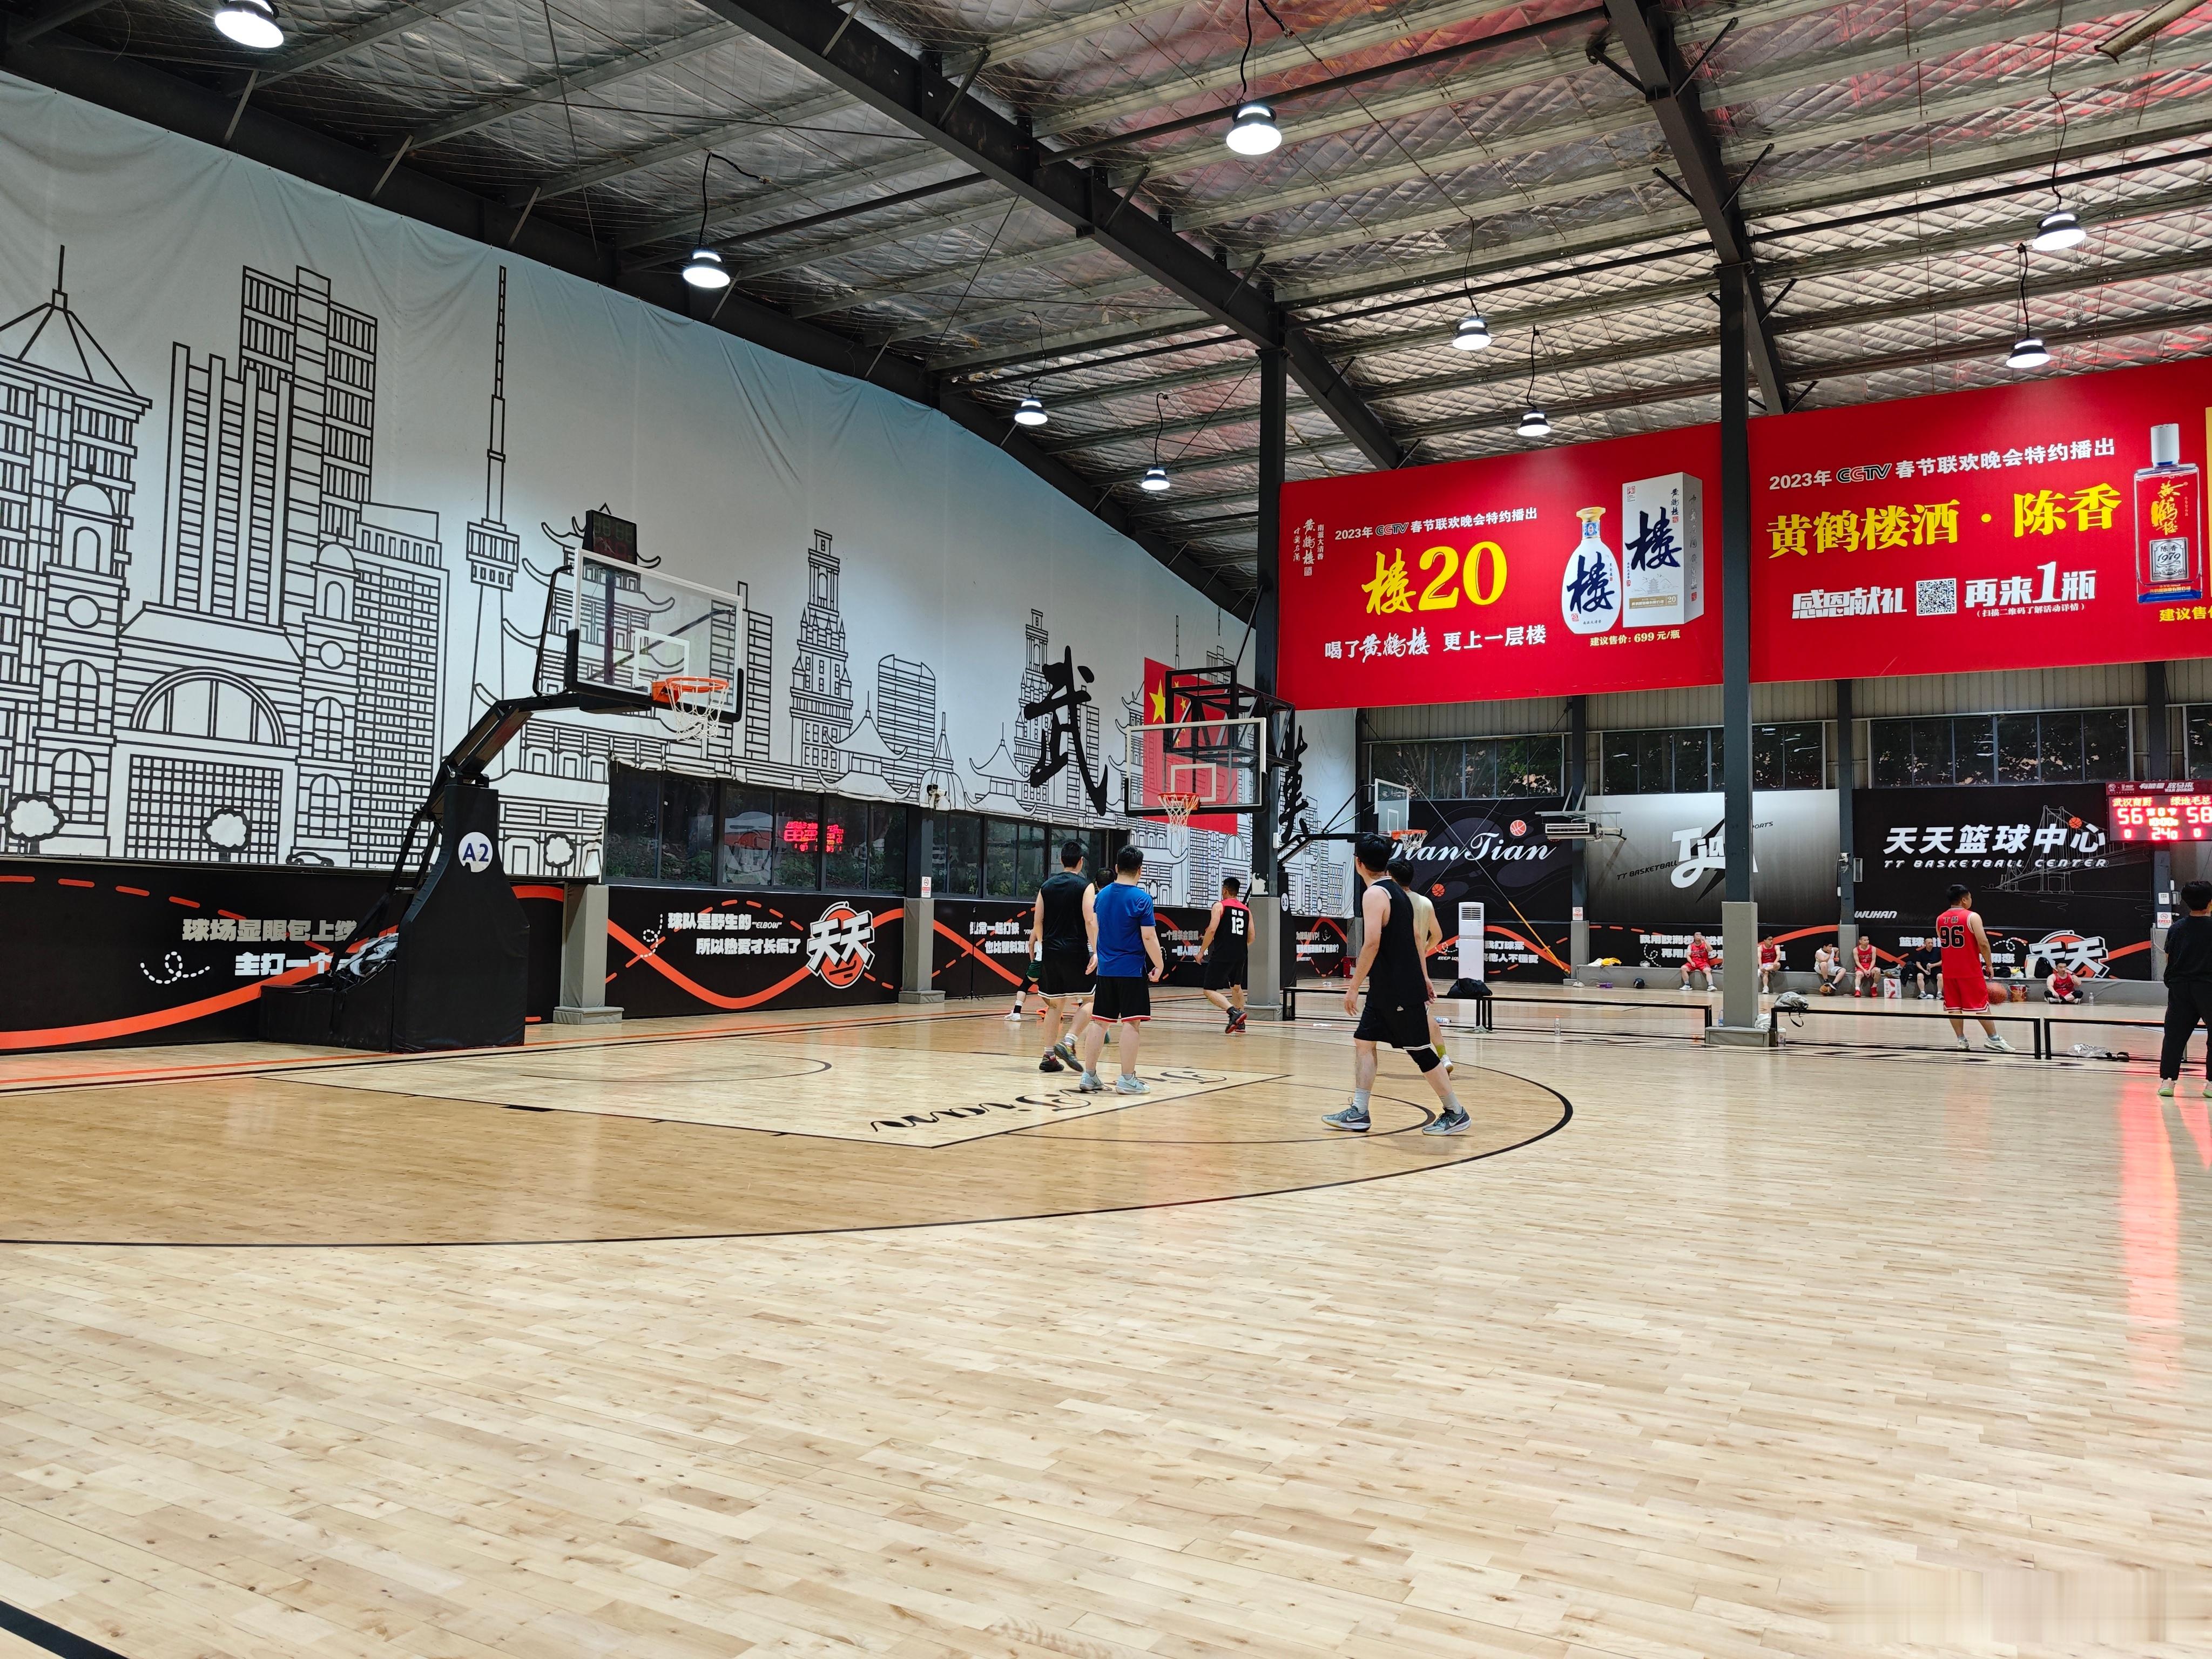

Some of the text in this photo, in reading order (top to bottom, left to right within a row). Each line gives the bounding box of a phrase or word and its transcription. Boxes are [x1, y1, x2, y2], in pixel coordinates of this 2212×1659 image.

[1769, 438, 2115, 490] 2023年 CCTV 春节联欢晚会特约播出
[1335, 507, 1537, 540] 2023年 CCTV 春节联欢晚会特约播出
[2157, 552, 2181, 563] 1979
[1965, 562, 2096, 608] 再来1瓶
[1792, 586, 1907, 619] 感恩献礼
[1325, 624, 1546, 663] 喝了黄鹤楼 更上一层楼
[1634, 632, 1654, 642] 699
[1656, 629, 1681, 640] 元/瓶
[1024, 645, 1108, 816] 武
[2117, 808, 2143, 825] 56
[2186, 806, 2212, 824] 58
[1883, 823, 2106, 854] 天天篮球中心
[2124, 829, 2132, 838] 0
[2194, 828, 2201, 838] 0
[462, 843, 489, 862] A2
[1616, 860, 1677, 880] TT BASKETBALL
[1884, 859, 2108, 869] TT BASKETBALL CENTER
[667, 913, 752, 931] 球队是野生的
[1854, 911, 1898, 919] WUHAN
[1231, 916, 1244, 935] 12
[808, 912, 873, 972] 天天
[1940, 925, 1965, 948] 96
[696, 938, 801, 955] 所以热爱才长疯了
